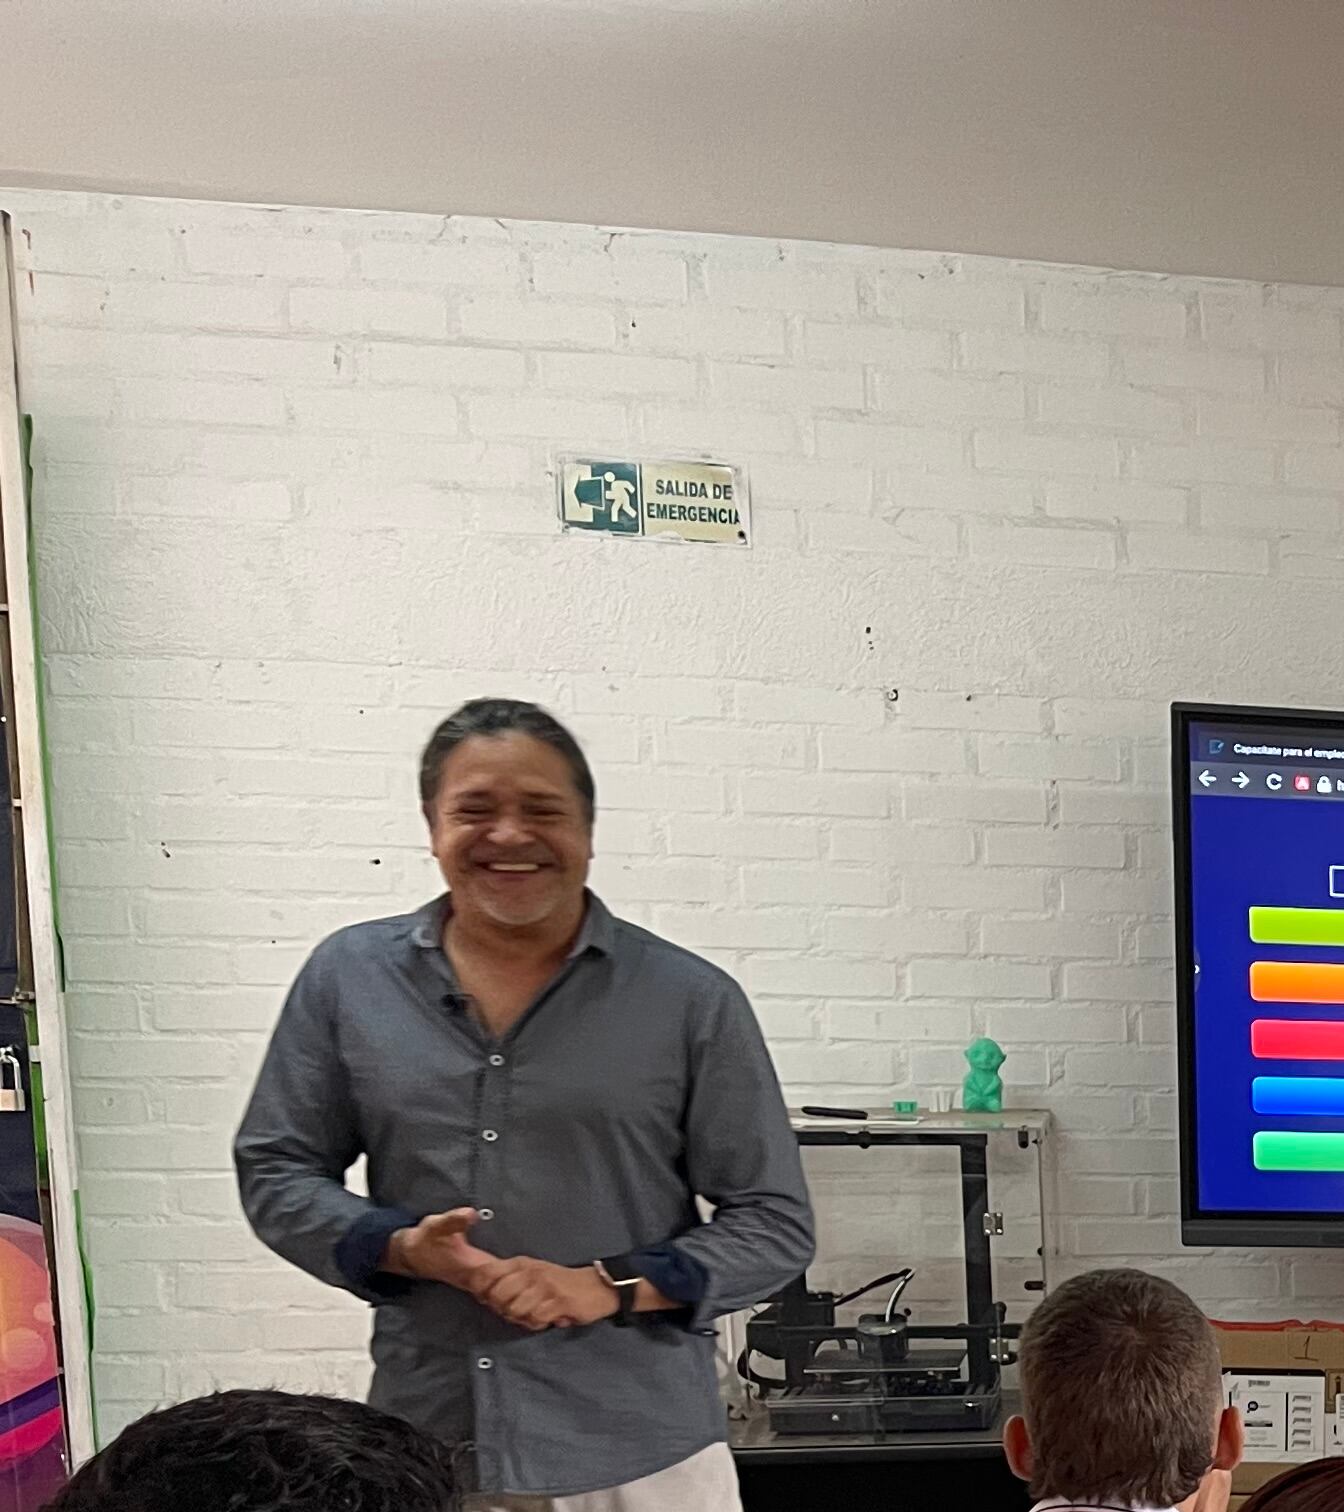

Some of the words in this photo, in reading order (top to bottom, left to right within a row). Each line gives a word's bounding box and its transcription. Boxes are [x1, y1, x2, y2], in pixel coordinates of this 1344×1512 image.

[656, 479, 708, 499] SALIDA
[713, 484, 733, 500] DE
[647, 503, 740, 525] EMERGENCIA
[1283, 748, 1303, 758] para
[1304, 747, 1313, 757] el
